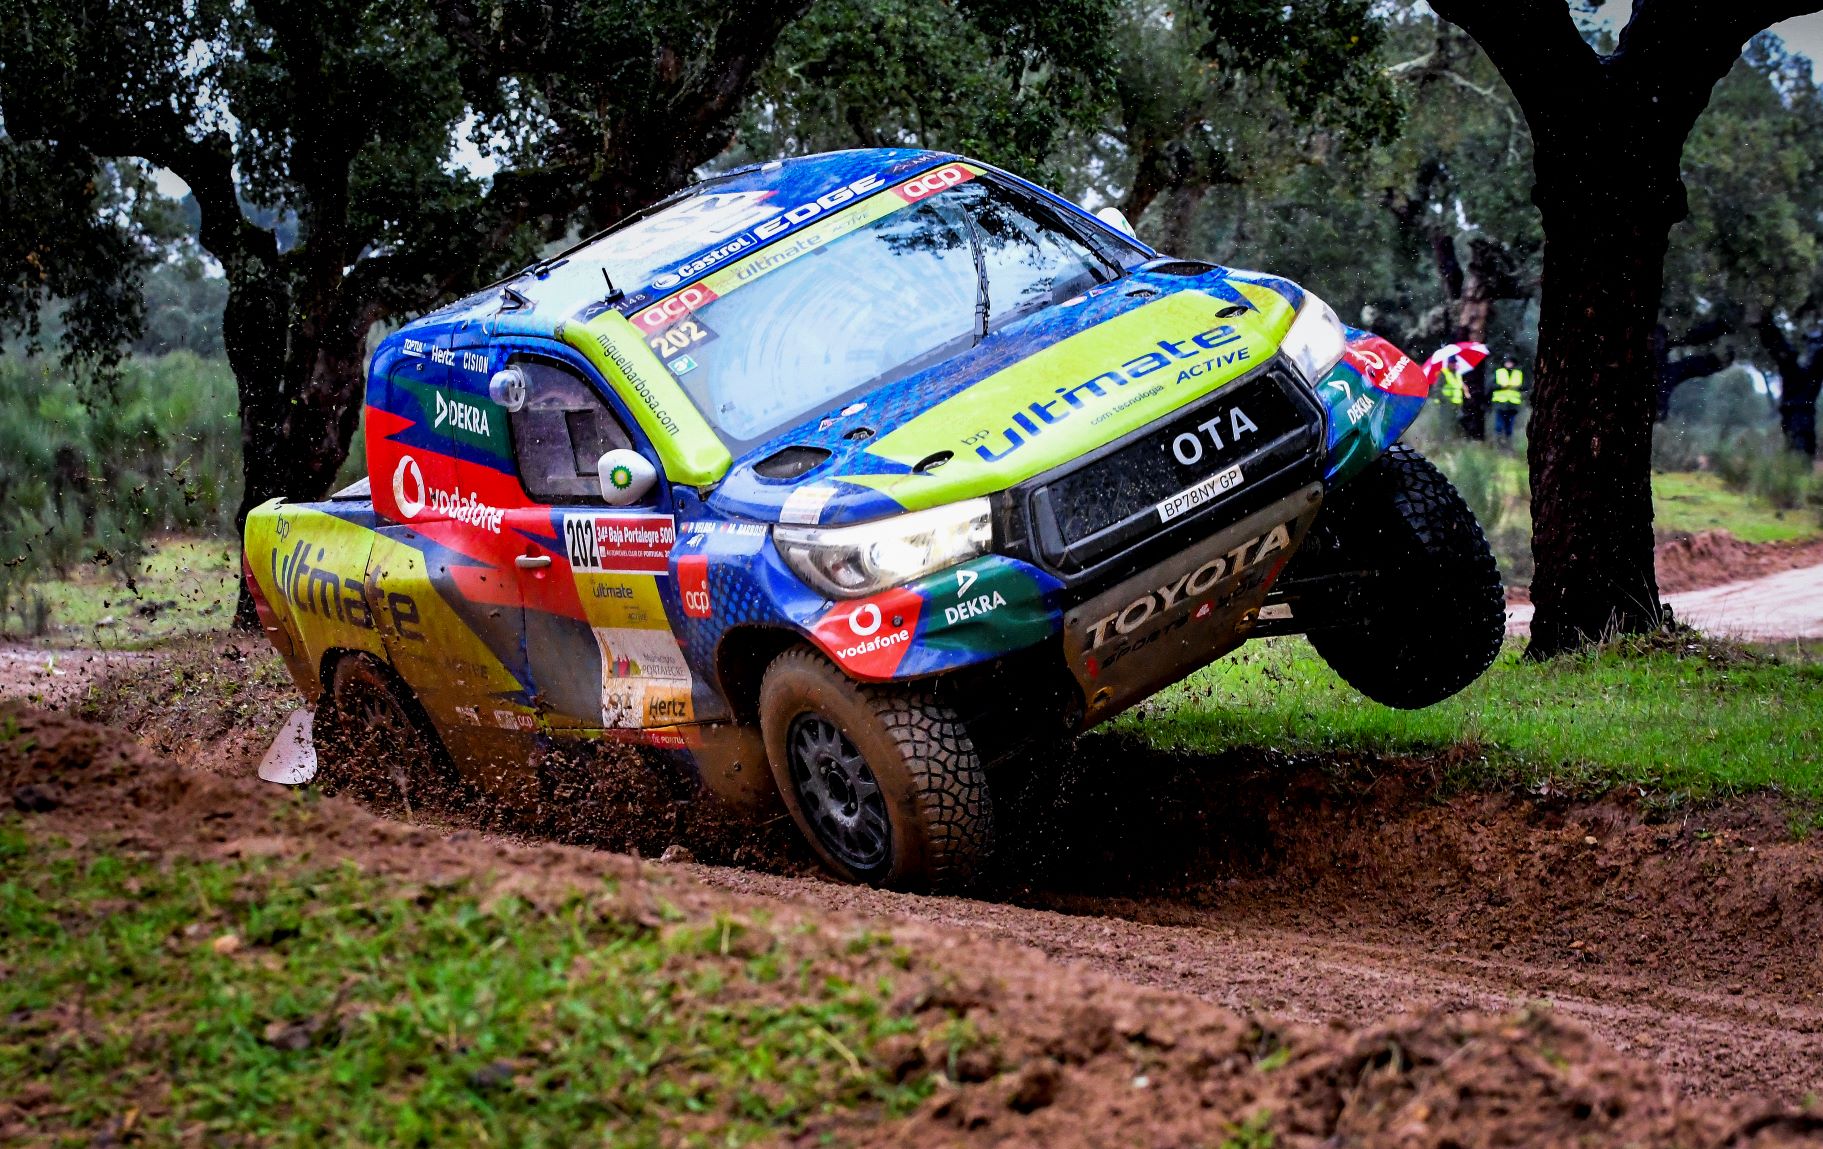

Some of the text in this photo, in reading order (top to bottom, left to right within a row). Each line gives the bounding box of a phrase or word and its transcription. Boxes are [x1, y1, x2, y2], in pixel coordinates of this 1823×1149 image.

[903, 168, 962, 198] acp
[678, 172, 886, 278] Castrol EDGE
[643, 288, 703, 327] acp
[431, 344, 456, 367] Hertz
[650, 320, 708, 359] 202
[463, 351, 489, 374] CISION
[1176, 347, 1251, 384] ACTIVE
[596, 333, 680, 437] miguelbarbosa.com
[975, 325, 1242, 463] ultimate
[448, 399, 491, 438] DEKRA
[1346, 393, 1375, 425] DEKRA
[960, 429, 990, 447] bp
[1171, 406, 1259, 466] OTA
[428, 486, 505, 534] vodafone
[1164, 470, 1239, 518] BP78NY GP
[275, 514, 291, 543] bp
[566, 519, 600, 568] 202
[608, 526, 623, 547] Baja
[623, 526, 660, 547] Portalegre
[660, 527, 673, 543] 500
[271, 540, 426, 642] ultimate
[592, 583, 634, 599] ultimate
[685, 580, 711, 614] acp
[1086, 523, 1290, 649] TOYOTA
[944, 591, 1007, 626] DEKRA
[836, 629, 910, 660] vodafone
[648, 696, 687, 717] Hertz
